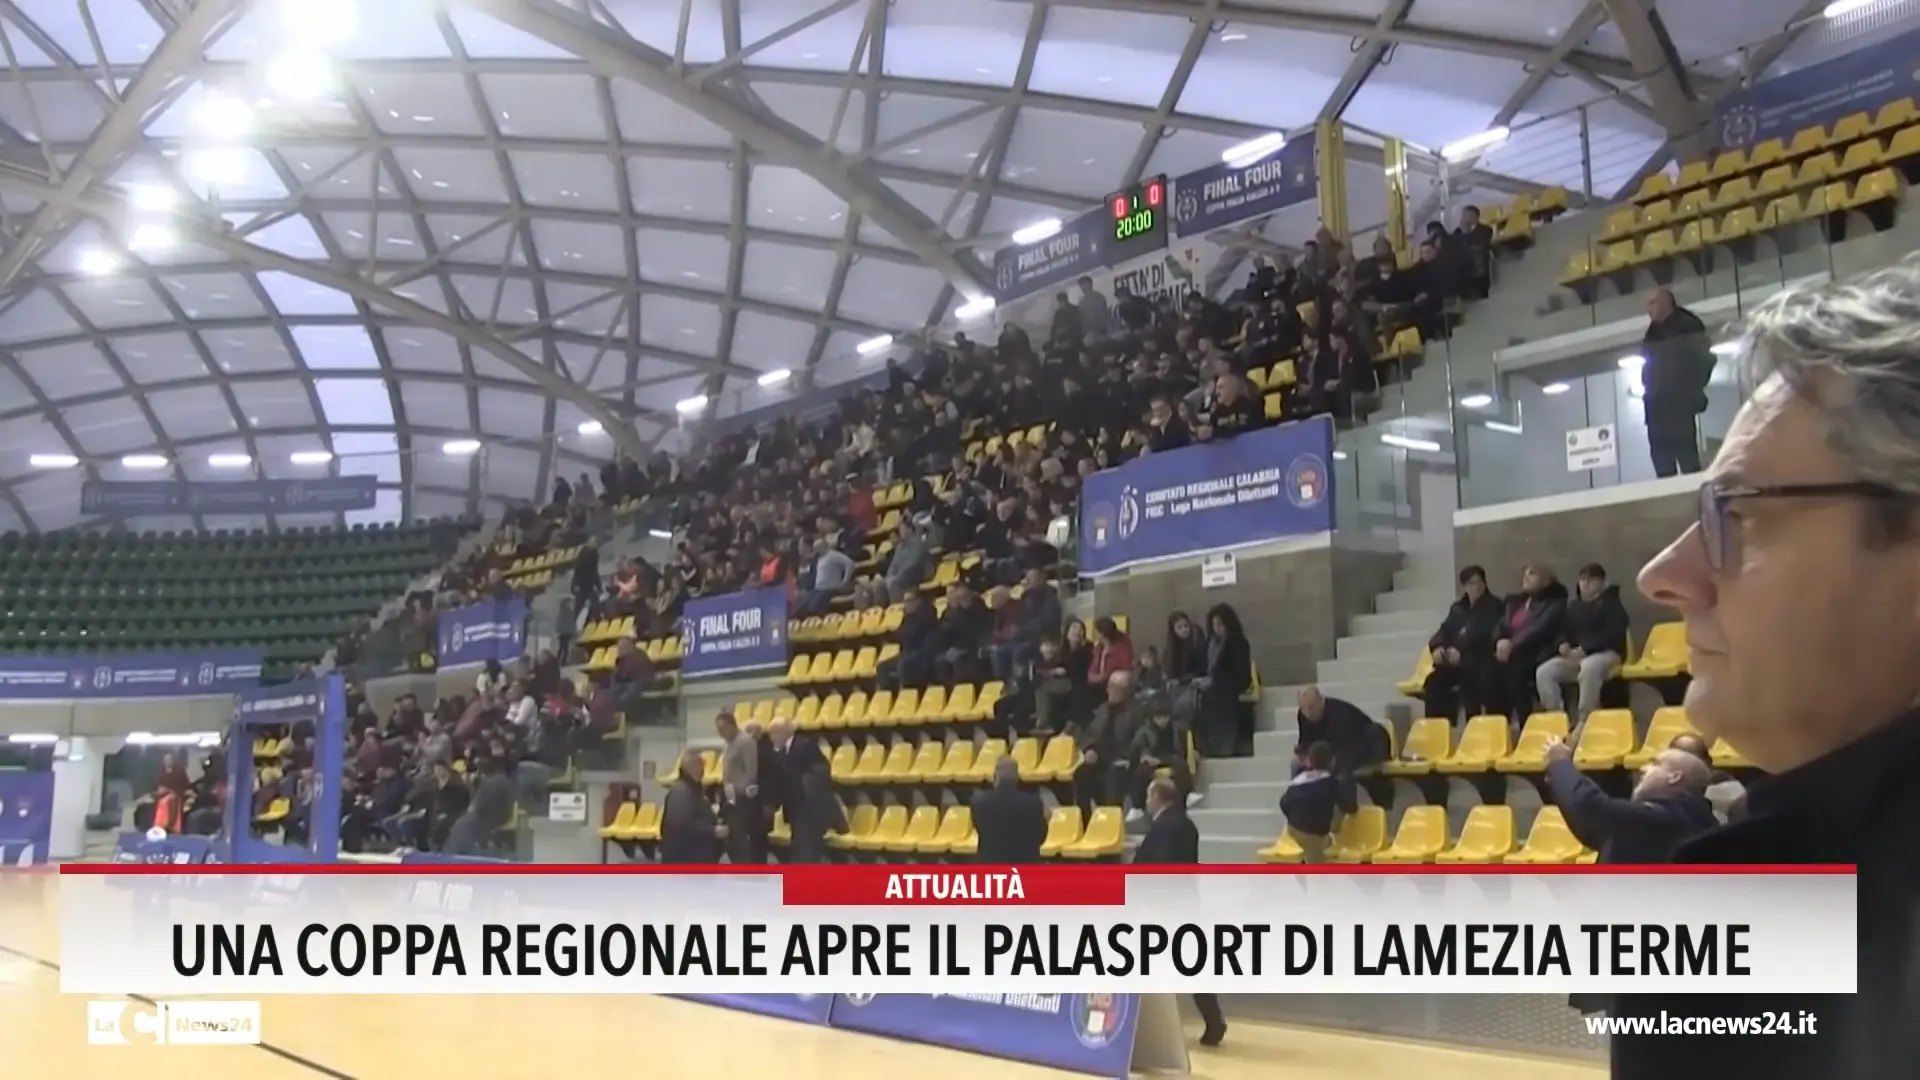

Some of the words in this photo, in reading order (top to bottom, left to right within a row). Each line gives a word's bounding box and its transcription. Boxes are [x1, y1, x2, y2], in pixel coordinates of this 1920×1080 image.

[1203, 174, 1243, 200] FINAL
[1244, 160, 1282, 188] FOUR
[1116, 210, 1153, 239] 20:00
[1018, 245, 1048, 270] FINAL
[1049, 233, 1080, 259] FOUR
[1151, 261, 1165, 289] DI
[700, 613, 730, 638] FINAL
[732, 607, 761, 634] FOUR
